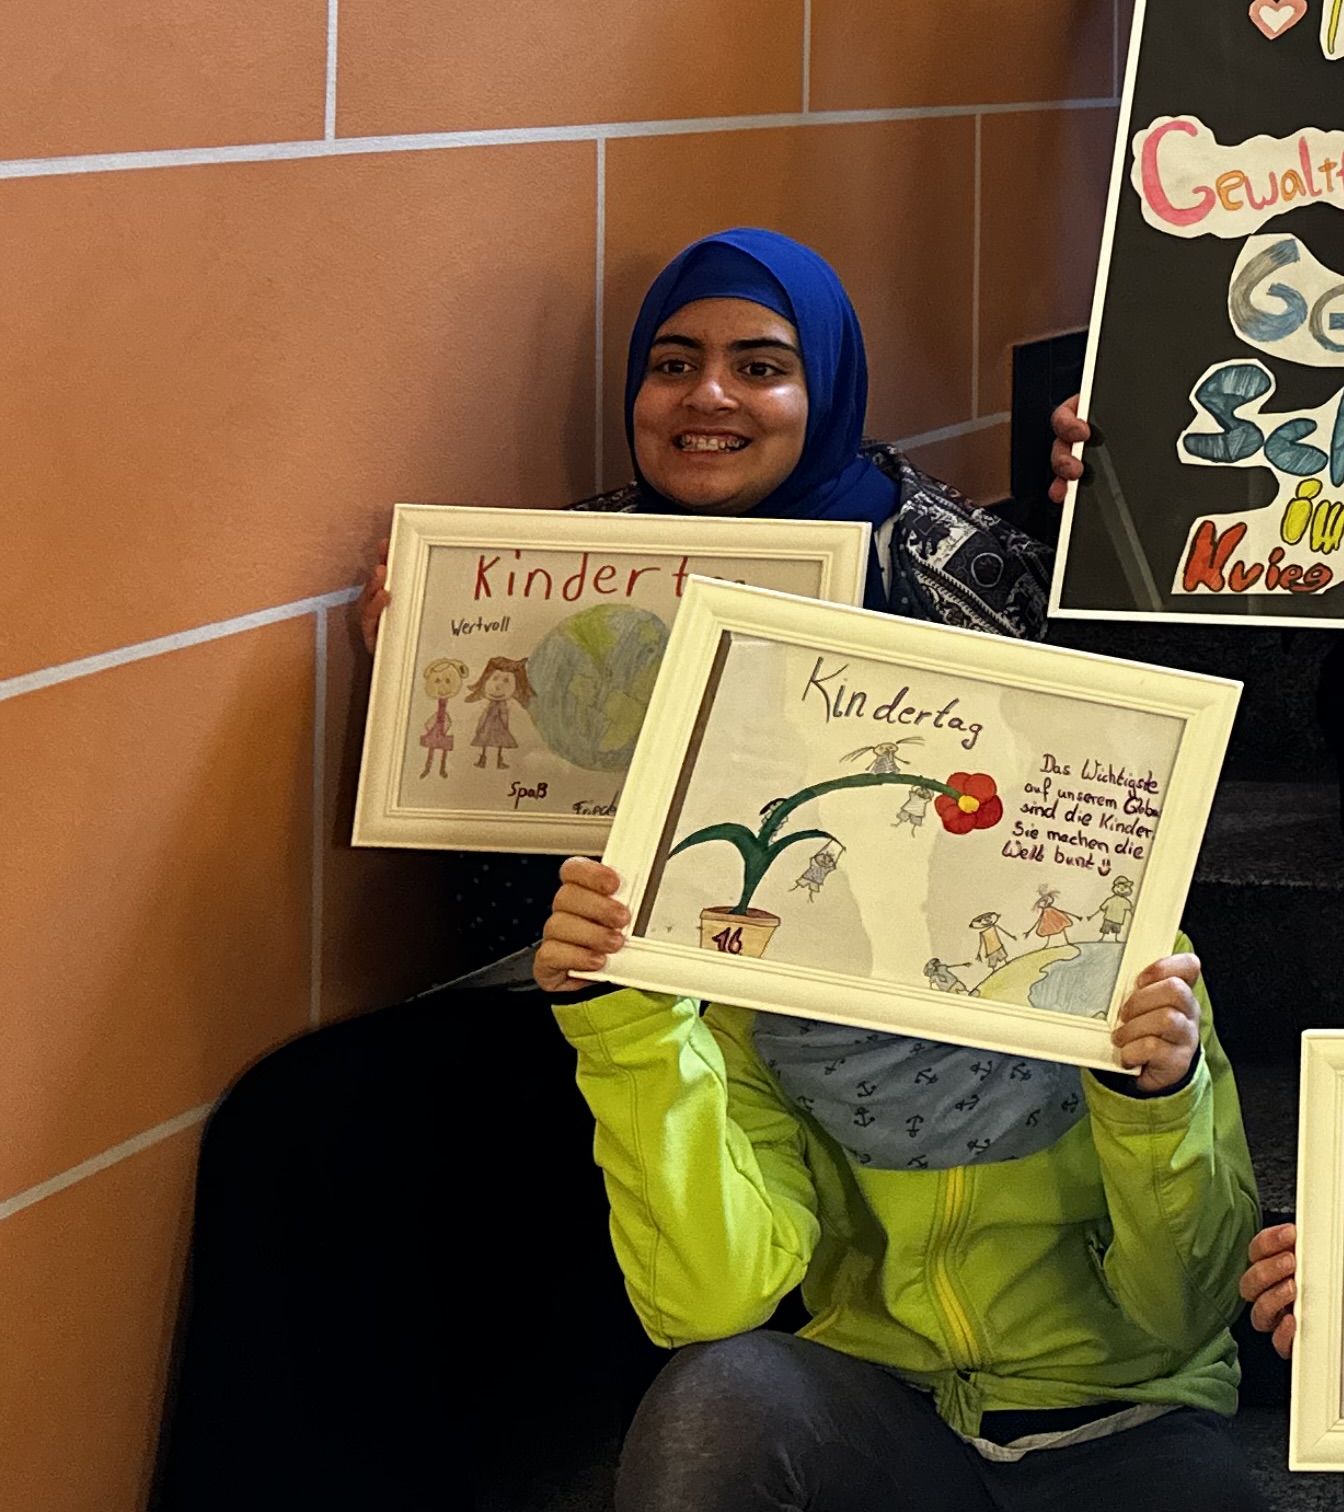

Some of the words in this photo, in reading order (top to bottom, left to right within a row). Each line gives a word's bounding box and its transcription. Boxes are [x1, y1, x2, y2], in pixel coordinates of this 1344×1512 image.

[451, 616, 511, 637] Wertvoll
[800, 656, 984, 750] Kindertag
[1040, 753, 1071, 776] Das
[1081, 758, 1160, 798] Wichtigste
[1024, 777, 1052, 803] auf
[1057, 788, 1118, 810] unserem
[1020, 798, 1059, 820] sind
[1064, 803, 1093, 827] die
[1001, 840, 1046, 863] Welt
[1054, 845, 1096, 871] bunt
[1012, 820, 1039, 841] Sie
[1047, 830, 1110, 855] machen
[1114, 837, 1145, 860] die
